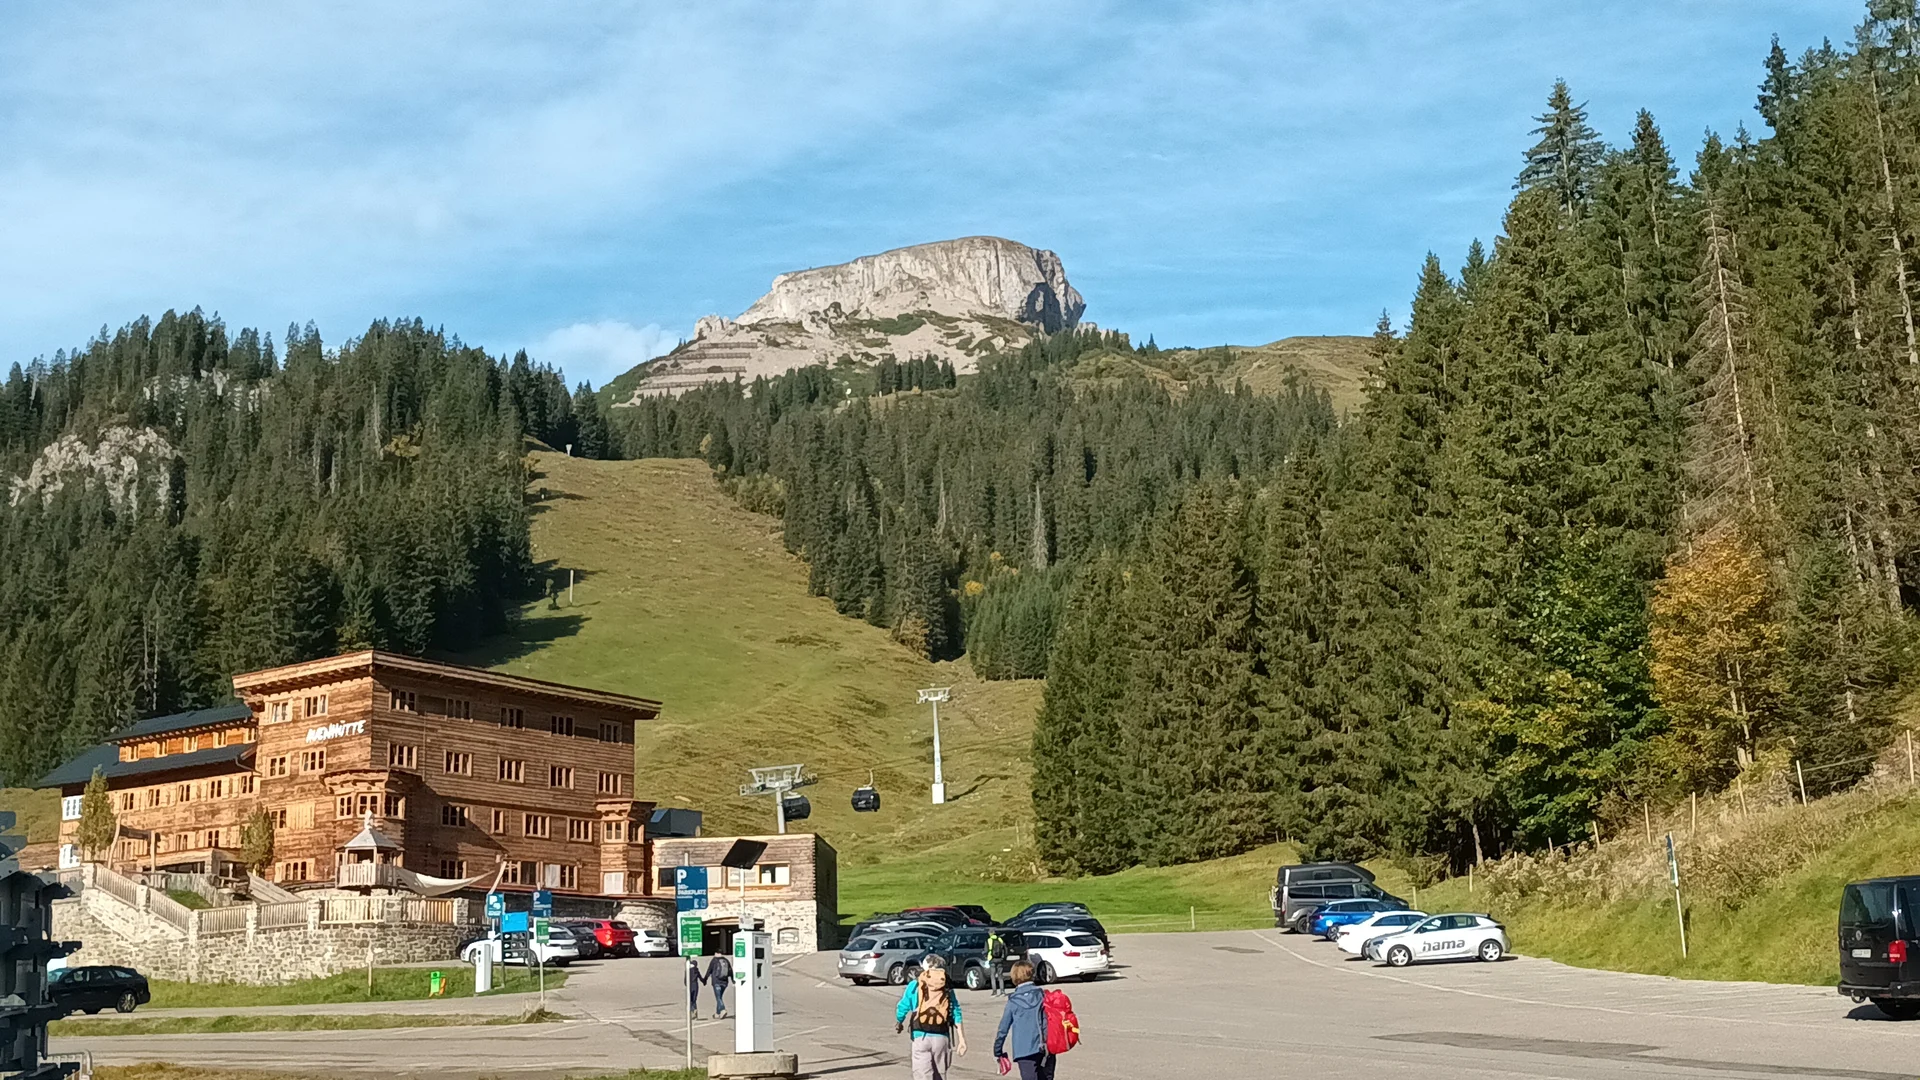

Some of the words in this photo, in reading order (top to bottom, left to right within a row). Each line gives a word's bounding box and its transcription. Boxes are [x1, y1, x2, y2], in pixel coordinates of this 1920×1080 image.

[305, 719, 367, 744] AUENHÜTTE
[677, 869, 687, 884] P
[533, 891, 540, 902] P
[1422, 939, 1466, 952] hama
